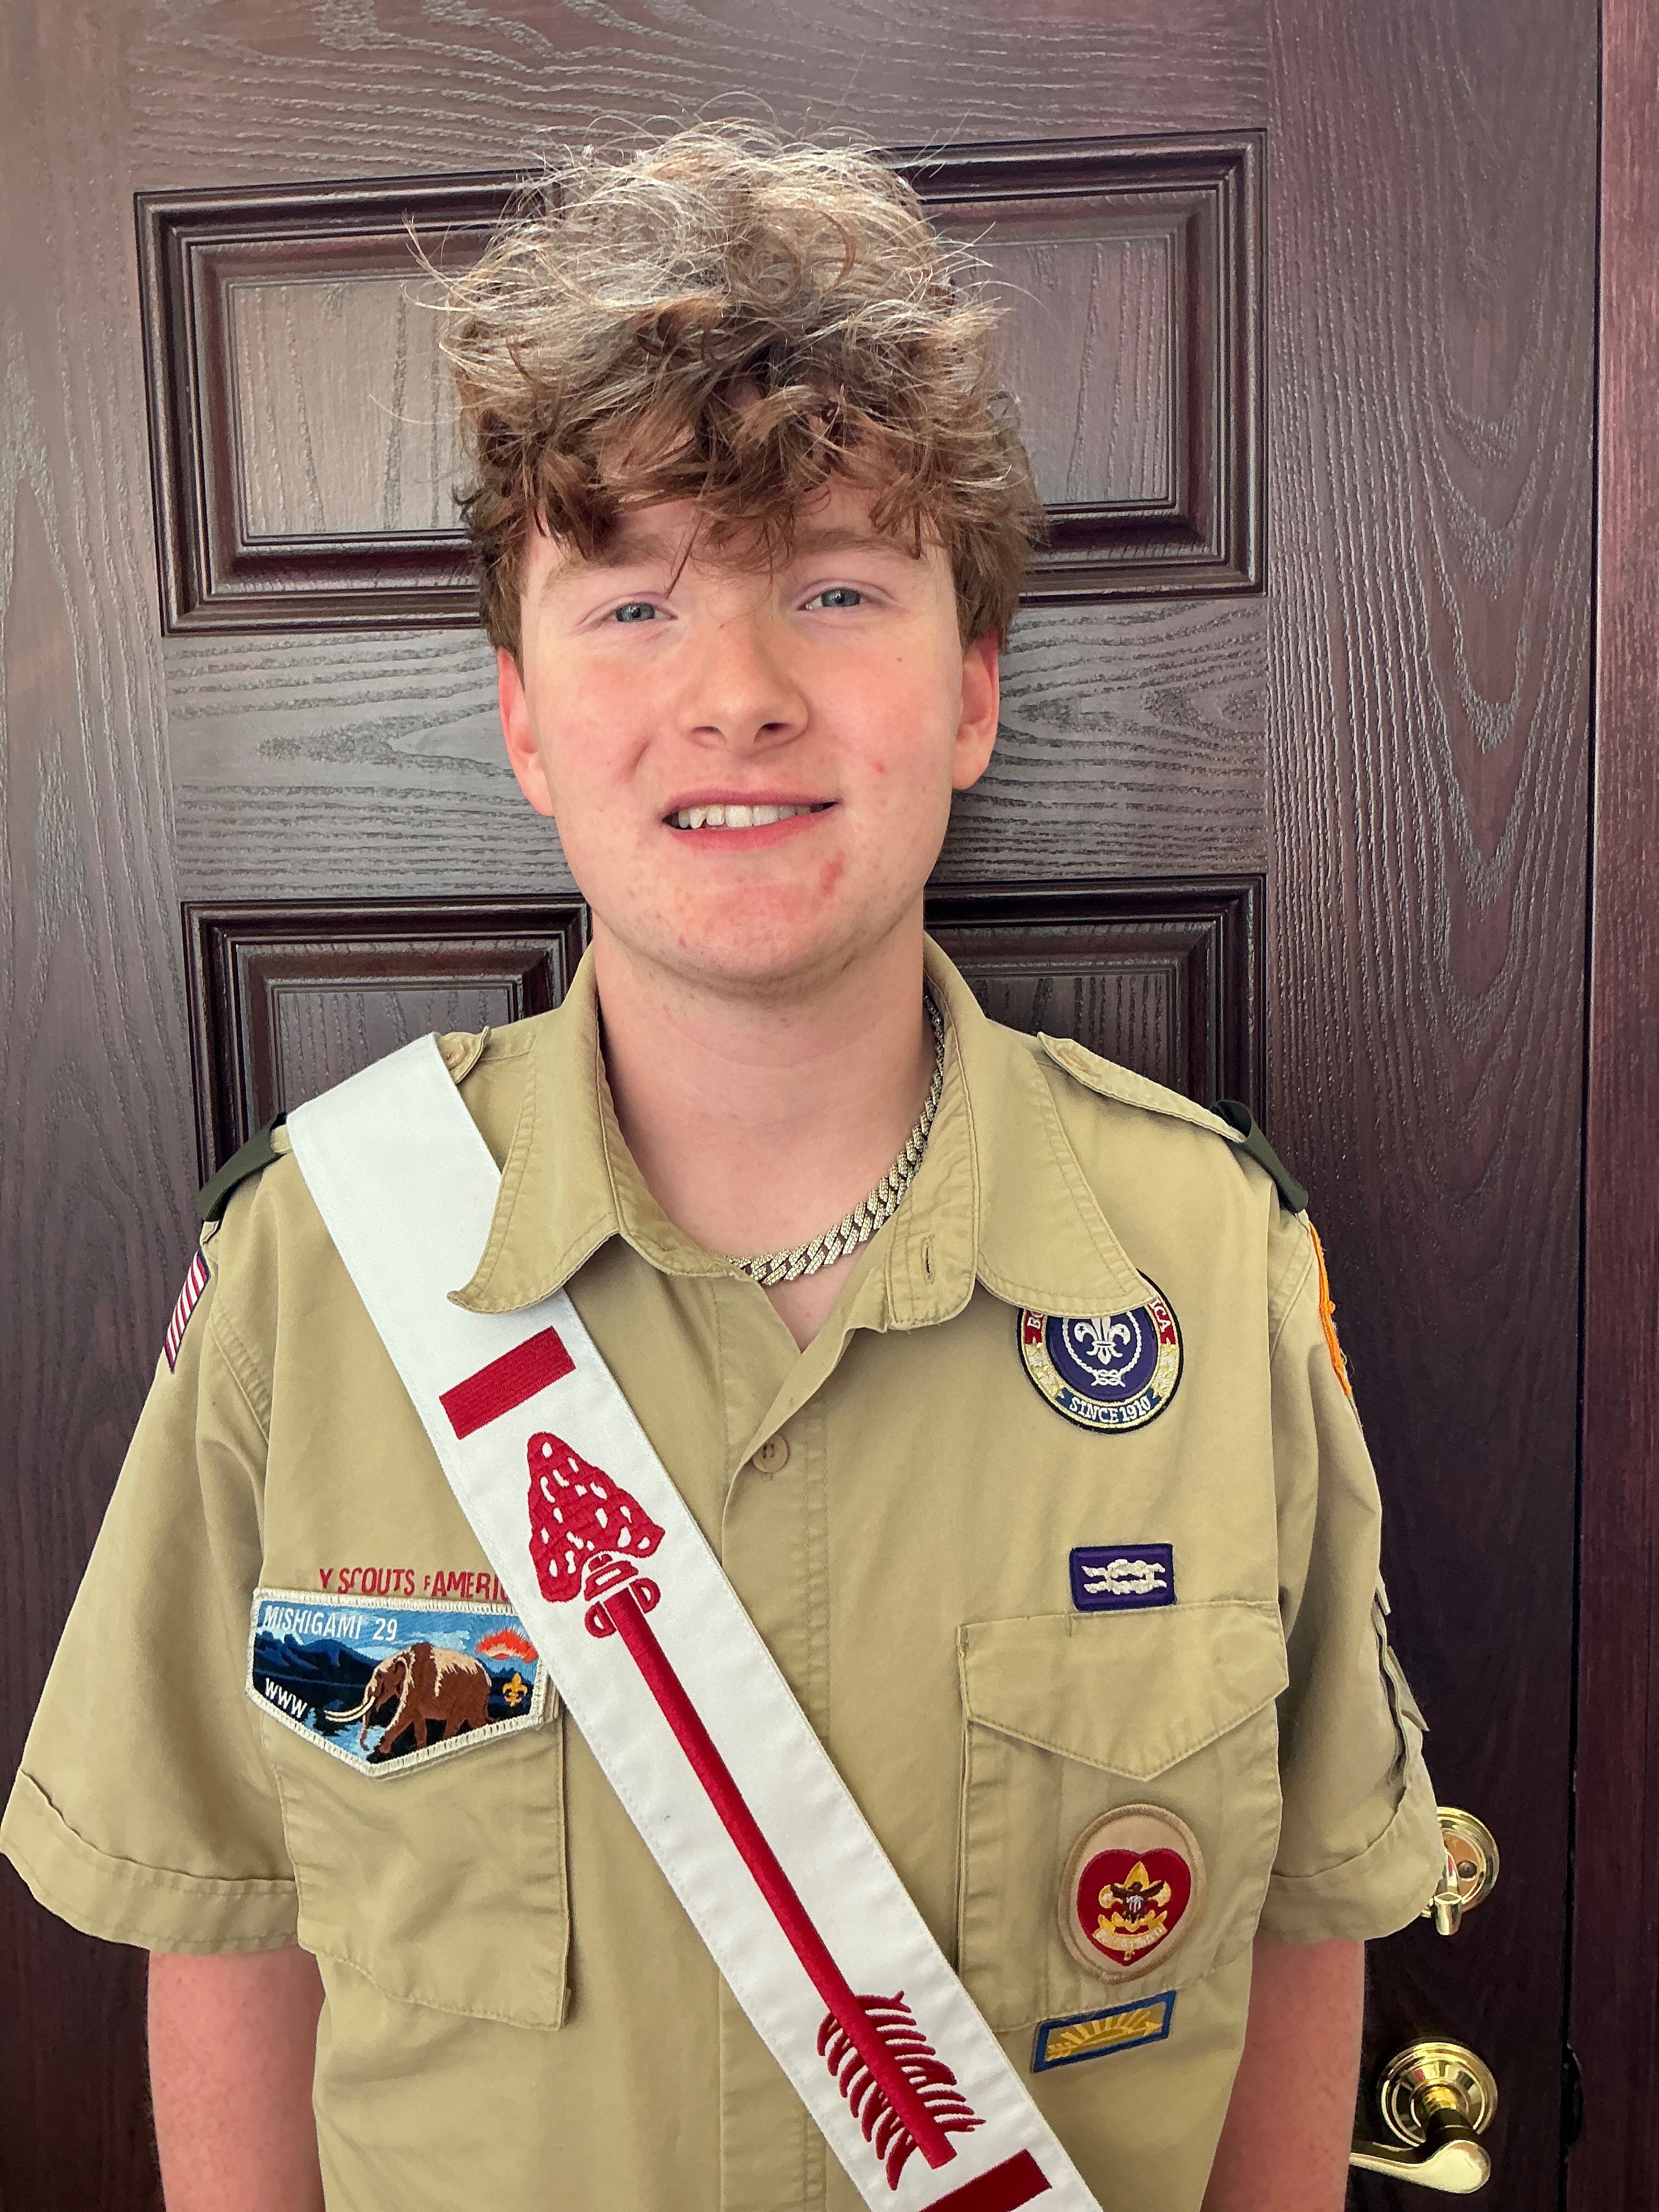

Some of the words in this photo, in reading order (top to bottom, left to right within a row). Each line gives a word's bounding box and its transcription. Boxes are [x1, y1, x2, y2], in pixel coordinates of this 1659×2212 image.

[1070, 1397, 1119, 1423] SINCE
[1119, 1396, 1151, 1421] 1910
[263, 1605, 362, 1639] MISHIGAMI
[372, 1618, 398, 1641] 29
[266, 1677, 308, 1718] WWW
